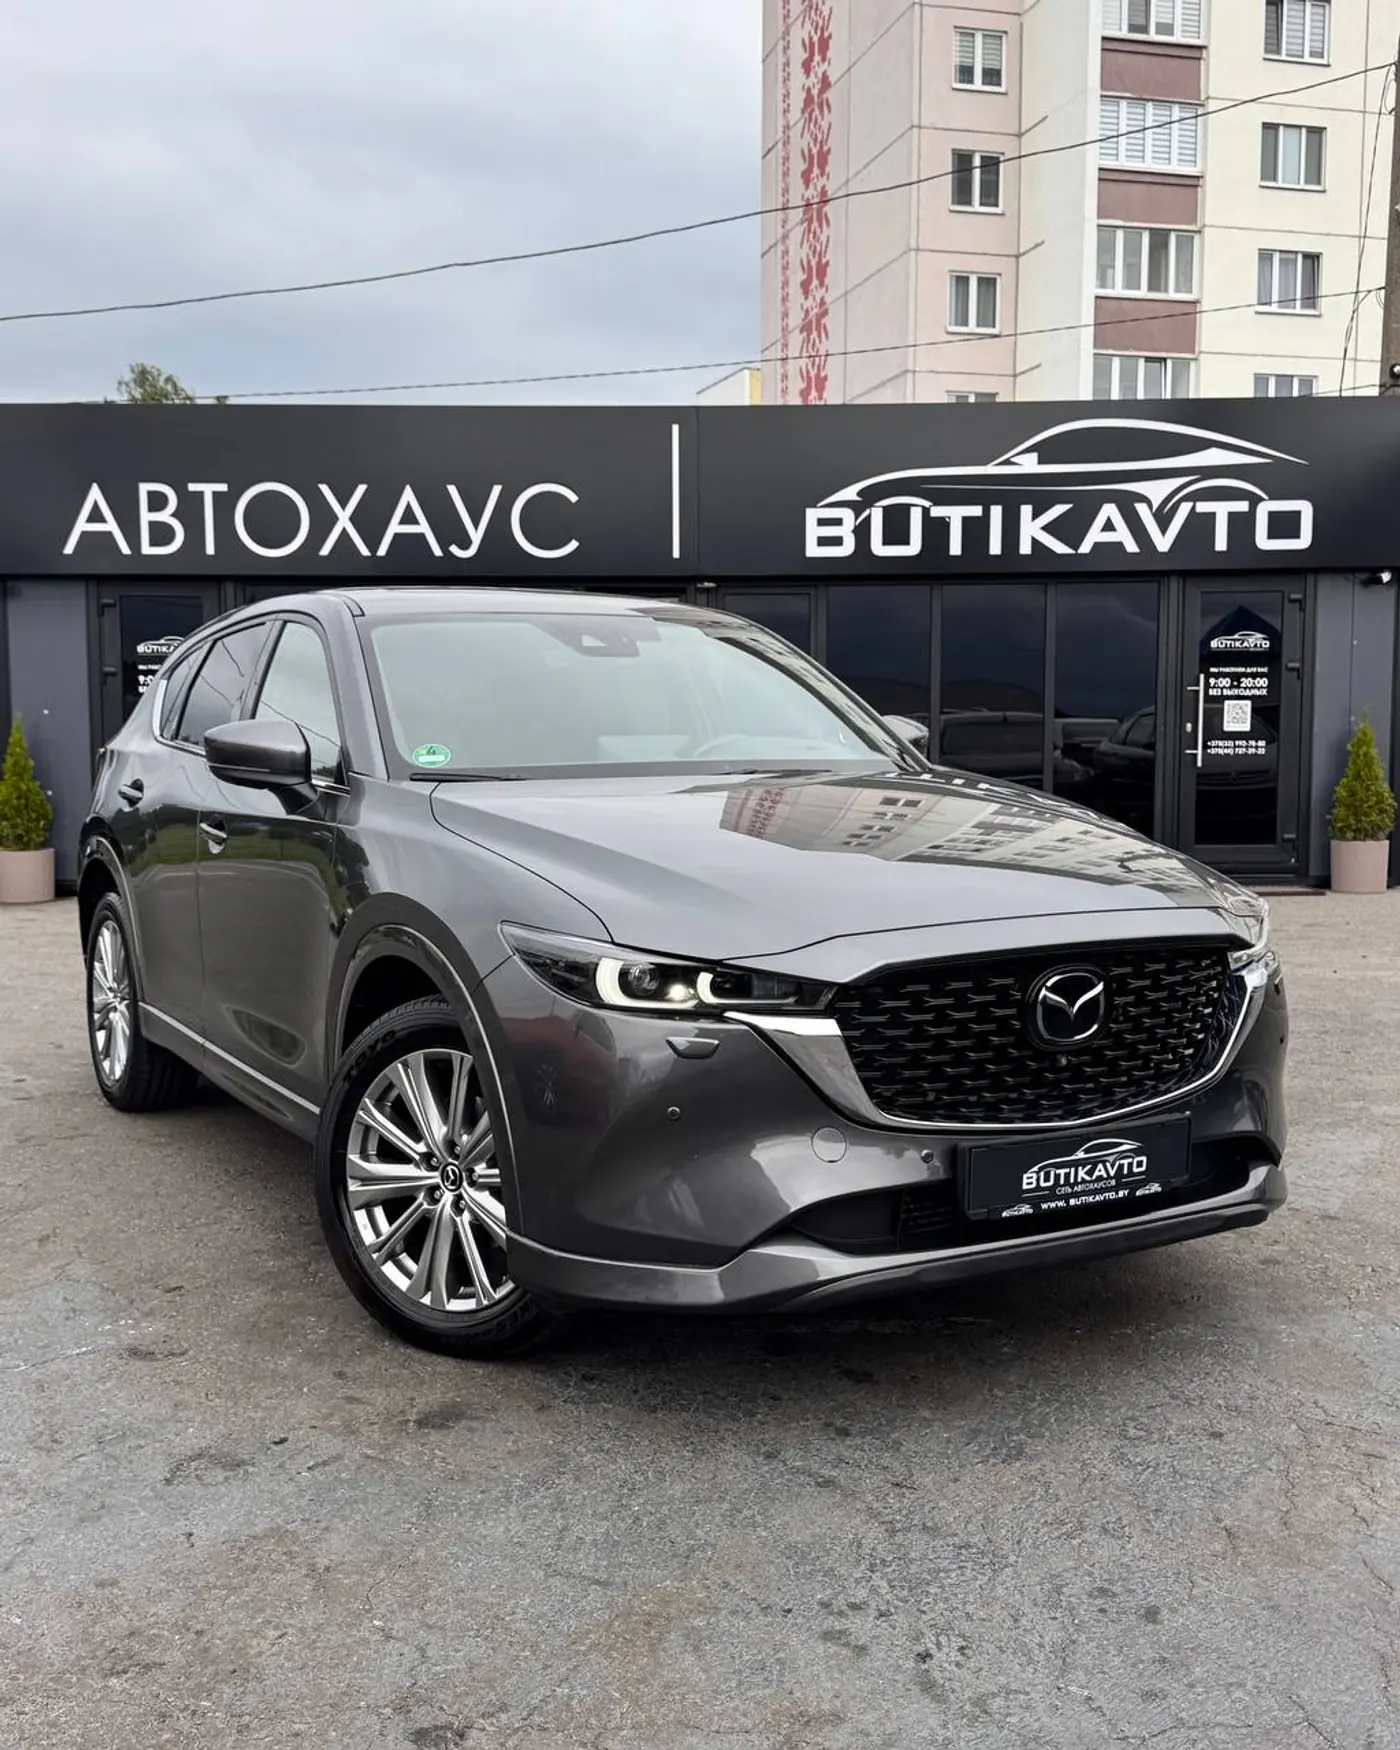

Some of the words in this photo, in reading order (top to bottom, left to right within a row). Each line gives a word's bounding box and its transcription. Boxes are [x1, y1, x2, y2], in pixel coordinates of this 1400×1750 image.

[63, 482, 579, 558] АВТОХАУС
[805, 499, 1313, 557] BUTIKAVTO
[1210, 640, 1270, 648] BUTIKAVTO
[1209, 677, 1231, 687] 9:00
[1240, 677, 1268, 687] 20:00
[1223, 688, 1268, 696] ВЫХОДНЫХ
[1021, 1156, 1147, 1190] BUTIKAVTO
[1069, 1189, 1130, 1206] BUTIKAVTO.BY
